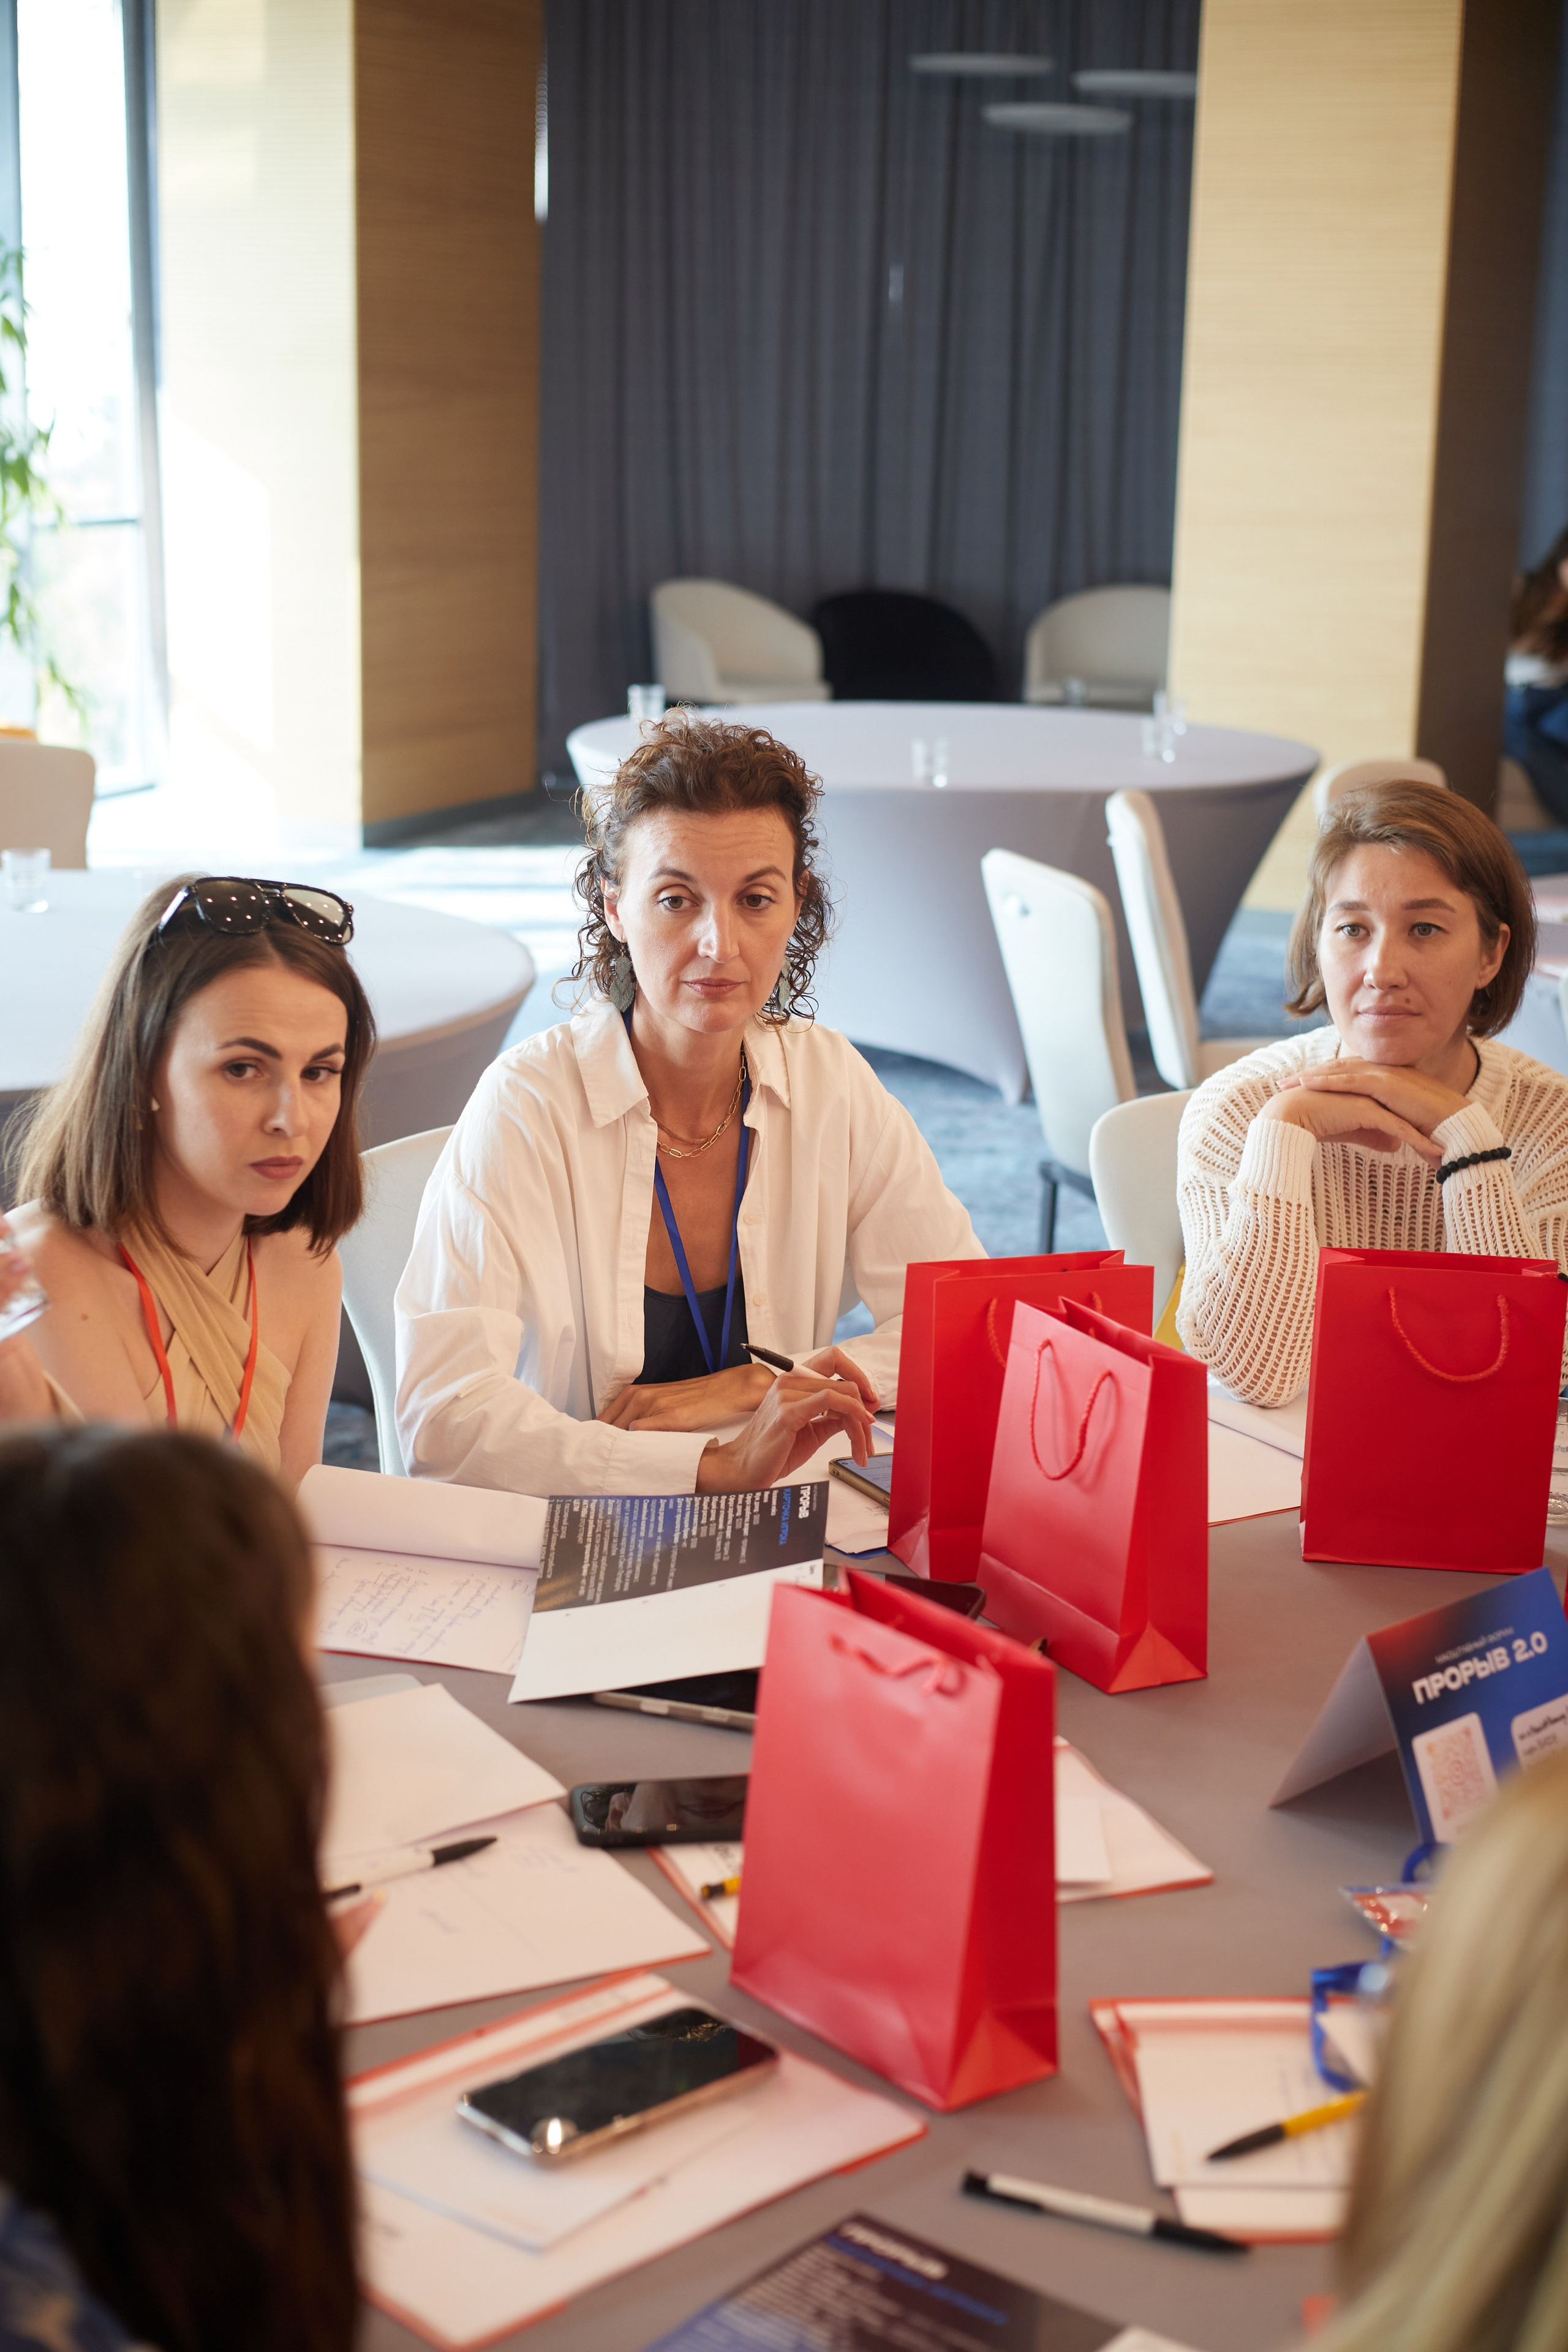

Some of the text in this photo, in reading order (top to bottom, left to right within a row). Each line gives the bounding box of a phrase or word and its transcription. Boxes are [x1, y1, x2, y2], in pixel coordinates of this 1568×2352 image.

[779, 1488, 791, 1545] КАРТОЧКА ИГРОКА
[798, 1485, 810, 1518] ПРОРЫВ
[1412, 1631, 1548, 1706] ПРОРЫВ 2.0
